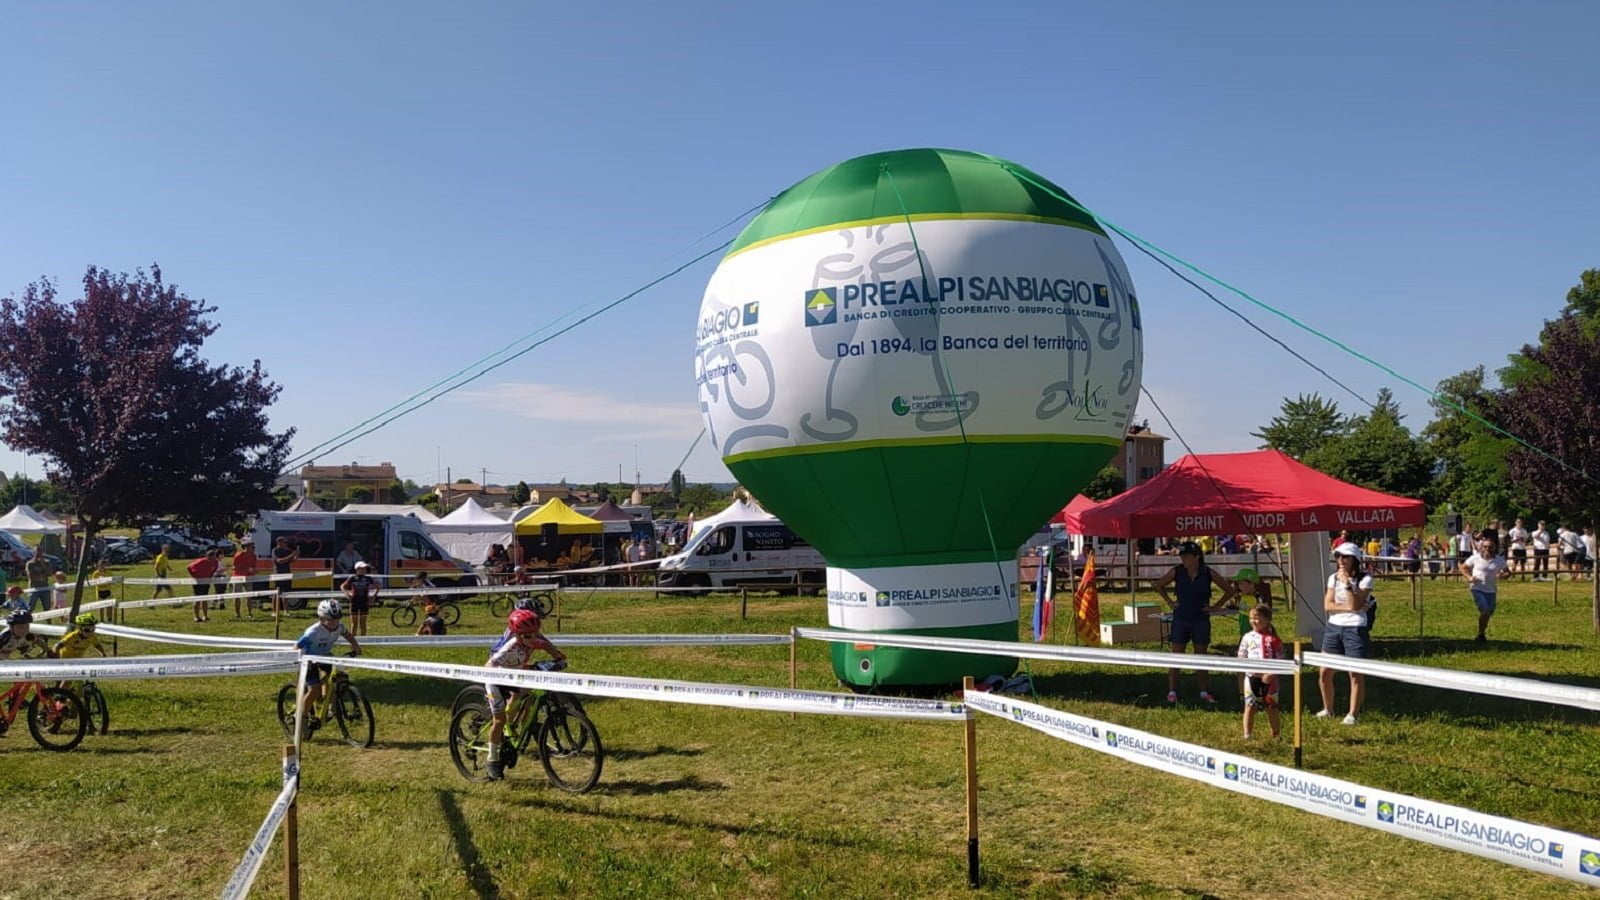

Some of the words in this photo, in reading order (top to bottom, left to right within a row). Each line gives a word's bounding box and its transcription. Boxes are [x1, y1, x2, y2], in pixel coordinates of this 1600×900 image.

[844, 312, 878, 322] BANCA
[880, 310, 892, 318] DI
[893, 307, 938, 317] CREDITO
[940, 305, 1010, 315] COOPERATIVO
[1018, 305, 1054, 315] GRUPPO
[1055, 308, 1080, 316] CASSA
[837, 341, 864, 357] Dal
[871, 338, 916, 354] 1894,
[920, 337, 936, 351] la
[943, 335, 998, 350] Banca
[1003, 335, 1028, 349] del
[1034, 334, 1088, 351] territorio
[1175, 515, 1224, 531] SPRINT
[1243, 513, 1285, 529] VIDOR
[1301, 511, 1319, 526] LA
[1337, 509, 1395, 524] VALLATA
